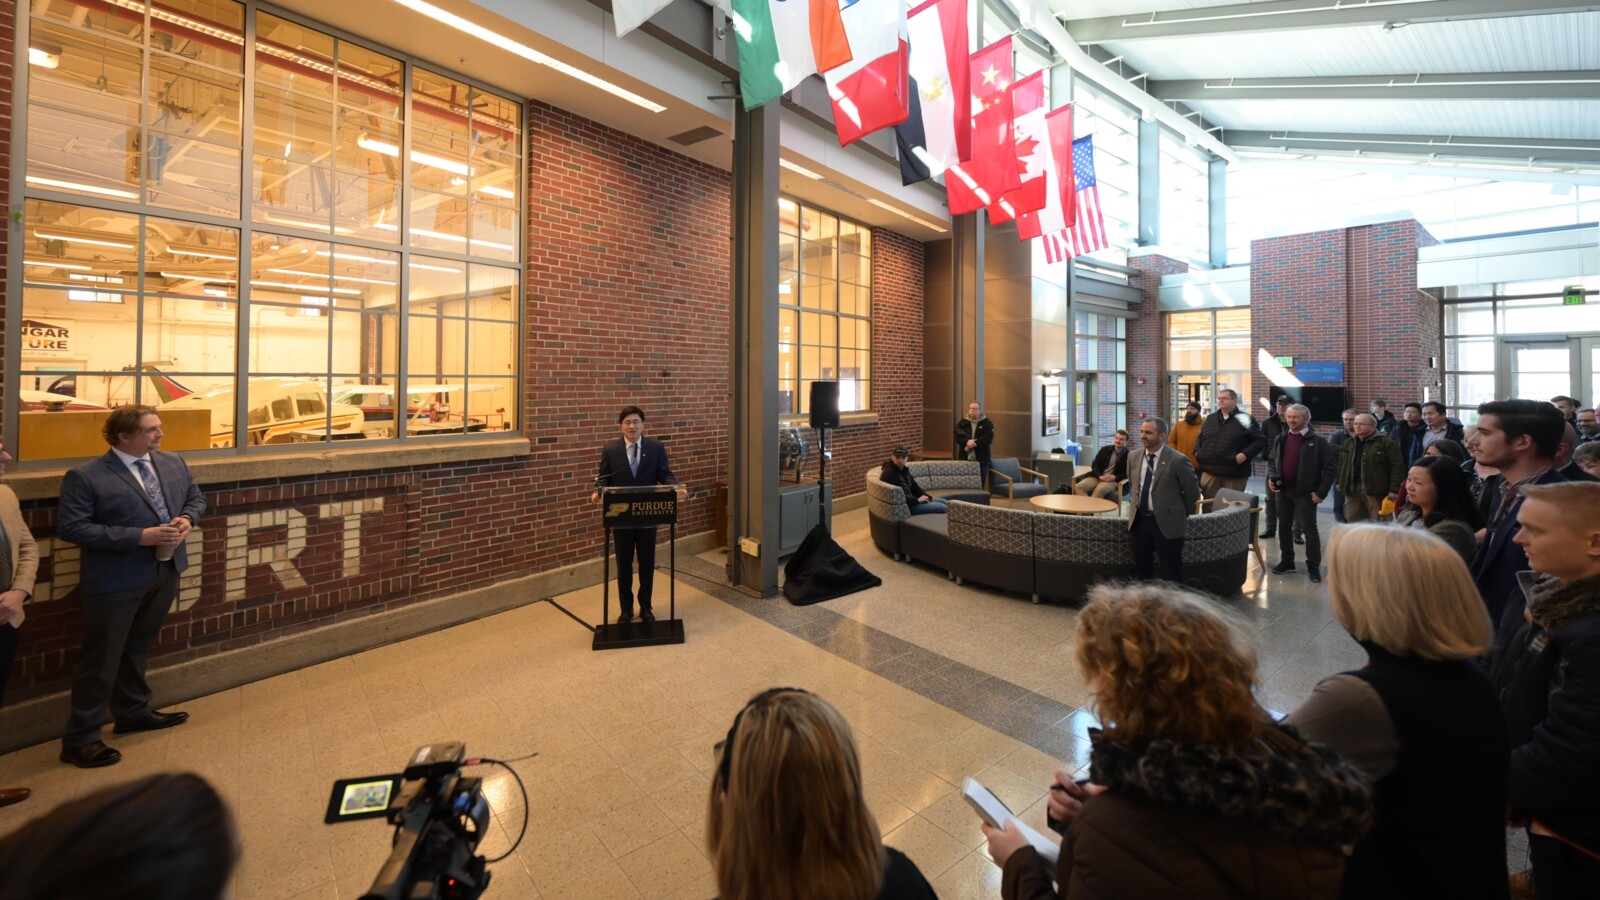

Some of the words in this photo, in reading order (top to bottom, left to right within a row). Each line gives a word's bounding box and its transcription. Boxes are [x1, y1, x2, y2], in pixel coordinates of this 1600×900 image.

[1565, 295, 1584, 305] EXIT
[22, 339, 67, 349] URE
[632, 501, 674, 511] PURDUE
